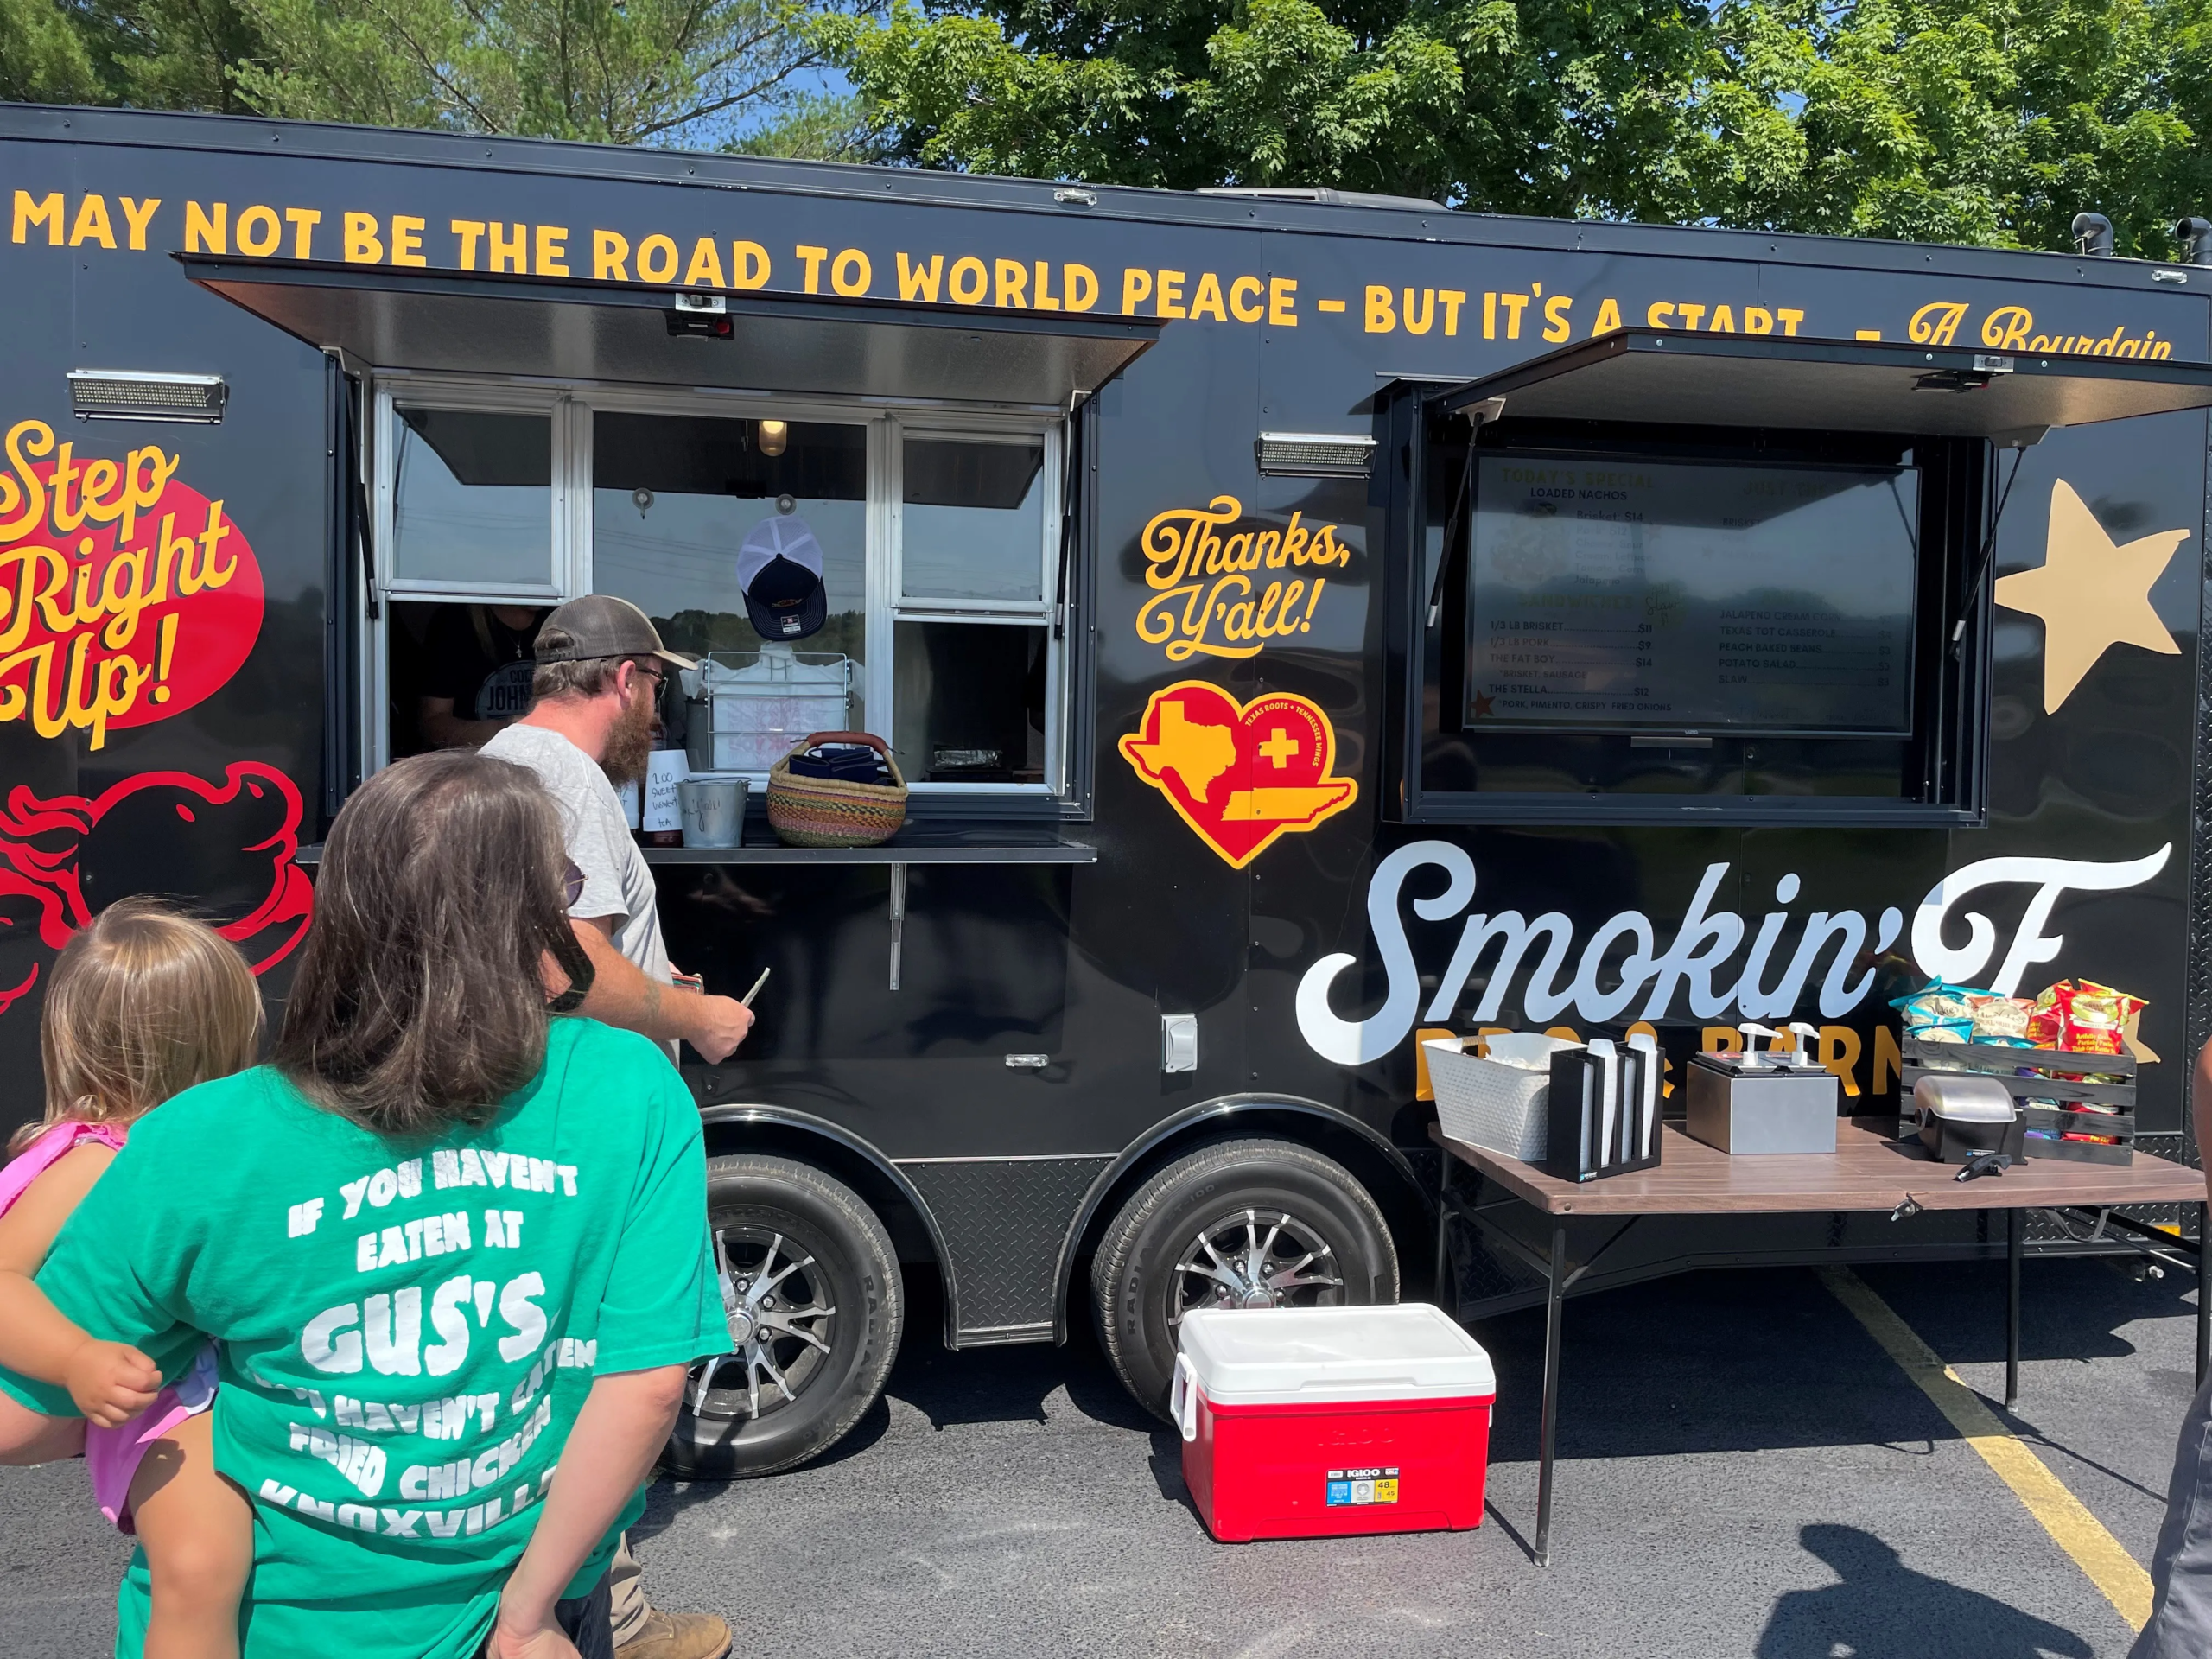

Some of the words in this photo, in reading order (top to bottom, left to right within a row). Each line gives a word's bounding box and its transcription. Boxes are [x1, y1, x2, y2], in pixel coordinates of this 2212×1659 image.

[12, 190, 162, 251] MAY
[185, 200, 321, 259] NOT
[345, 211, 426, 267] BE
[451, 219, 569, 276] THE
[594, 230, 771, 289] ROAD
[795, 245, 871, 296] TO
[896, 252, 1098, 312] WORLD
[1122, 268, 1297, 327] PEACE
[1365, 284, 1466, 336] BUT
[1483, 282, 1573, 343] IT'S
[1592, 299, 1623, 338] A
[0, 420, 180, 543] Step
[1530, 487, 1575, 499] LOADED
[1579, 489, 1628, 501] NACHOS
[1141, 494, 1351, 590] Thanks,
[0, 499, 238, 653] Right
[1135, 574, 1325, 662] Y'all!
[1491, 620, 1506, 630] 1/3
[1509, 621, 1521, 631] LB
[1522, 621, 1564, 632] BRISKET
[1638, 623, 1652, 634] $11
[1719, 626, 1752, 636] TEXAS
[1755, 627, 1775, 637] TOT
[1774, 611, 1809, 621] CREAM
[1490, 637, 1505, 647] 1/3
[1508, 638, 1520, 647] LB
[1522, 638, 1549, 648] PORK
[1638, 640, 1651, 651] $9
[1491, 654, 1510, 664] THE
[1511, 654, 1531, 664] FAT
[1534, 654, 1555, 664] BOY
[1636, 658, 1652, 668] $14
[1719, 642, 1753, 652] PEACH
[1755, 644, 1787, 653] BAKED
[1719, 658, 1760, 668] POTATO
[0, 613, 180, 752] Up!
[1489, 683, 1508, 693] THE
[1511, 684, 1547, 695] STELLA
[1719, 675, 1748, 684] SLAW
[1244, 708, 1264, 727] TEXAS
[1264, 702, 1288, 712] ROOTS
[1575, 701, 1606, 710] CRISPY
[1611, 702, 1634, 711] FRIED
[1637, 702, 1672, 712] ONIONS
[1296, 706, 1322, 741] TENNESSEE
[1312, 742, 1323, 768] WINGS
[1294, 839, 1904, 1065] Smokin'
[287, 1197, 325, 1238] IF
[339, 1158, 423, 1220] YOU
[356, 1211, 471, 1273] EATEN
[484, 1209, 524, 1249] AT
[301, 1271, 548, 1376] GUS'S
[334, 1392, 500, 1440] HAVEN'T
[289, 1422, 387, 1499] FRIED
[399, 1395, 551, 1502] CHICKEN
[1347, 1469, 1380, 1478] IGLOO
